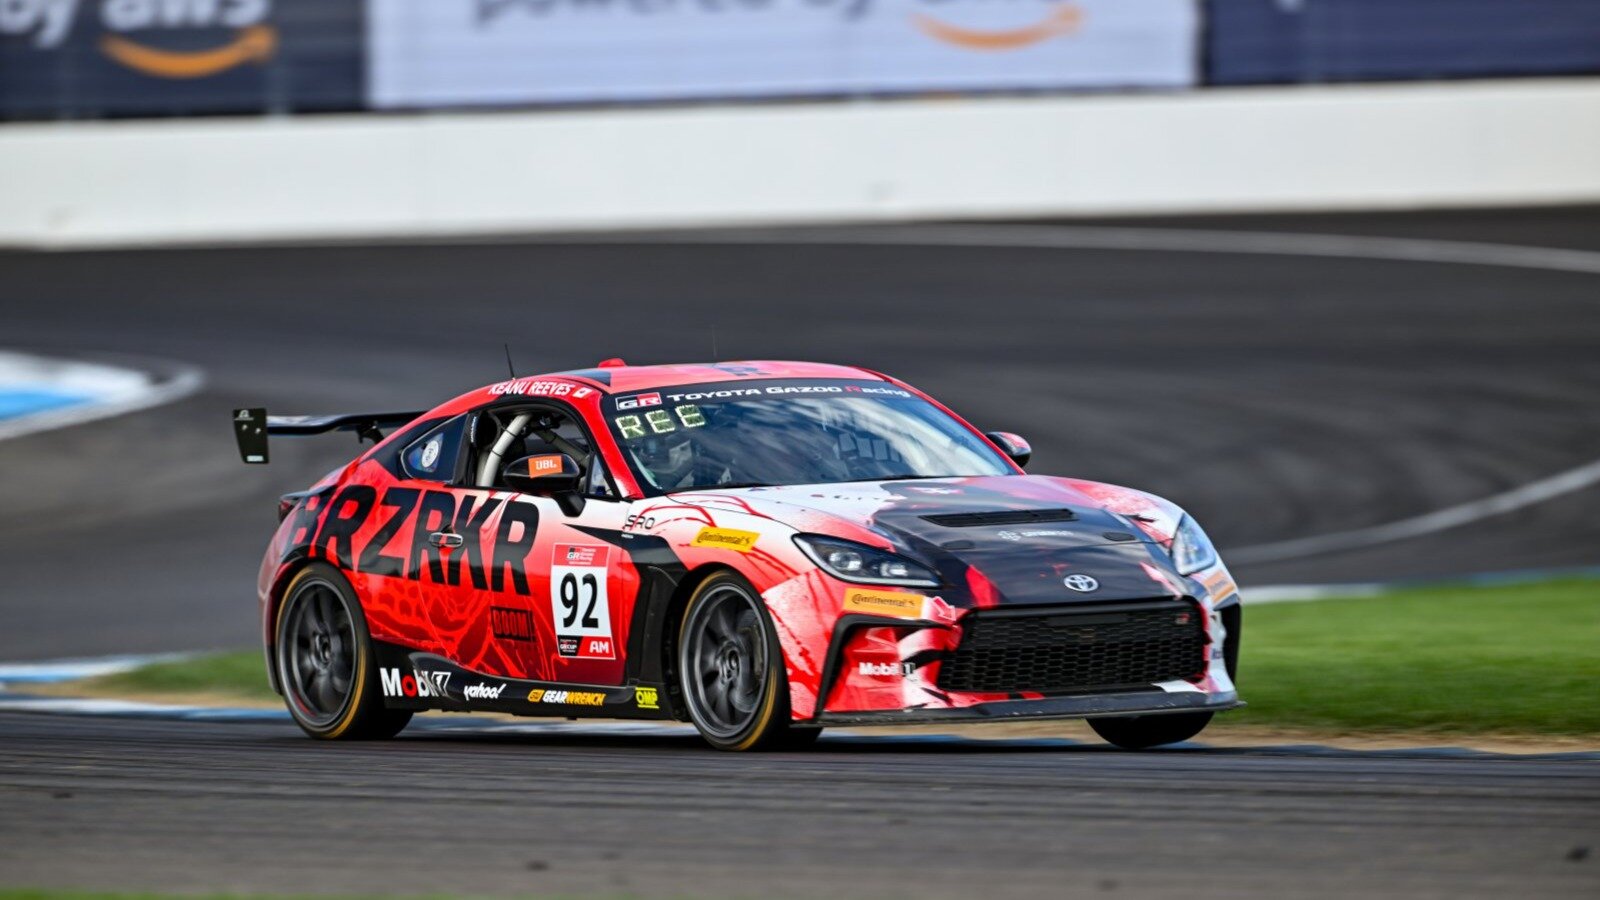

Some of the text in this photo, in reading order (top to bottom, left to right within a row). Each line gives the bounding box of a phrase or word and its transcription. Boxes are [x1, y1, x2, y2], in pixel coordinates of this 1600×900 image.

[488, 381, 575, 396] KEANU REEVES
[667, 388, 762, 402] TOYOTA
[766, 386, 842, 394] GAZOO
[618, 397, 660, 410] GR
[615, 404, 706, 439] REE
[535, 459, 558, 470] JBL
[623, 514, 655, 530] SRO
[280, 485, 540, 596] BRZRKR
[560, 572, 599, 629] 92
[590, 640, 610, 654] AM
[859, 662, 900, 676] Mobil
[463, 682, 507, 701] yahoo!
[543, 689, 606, 705] GEARWRENCH
